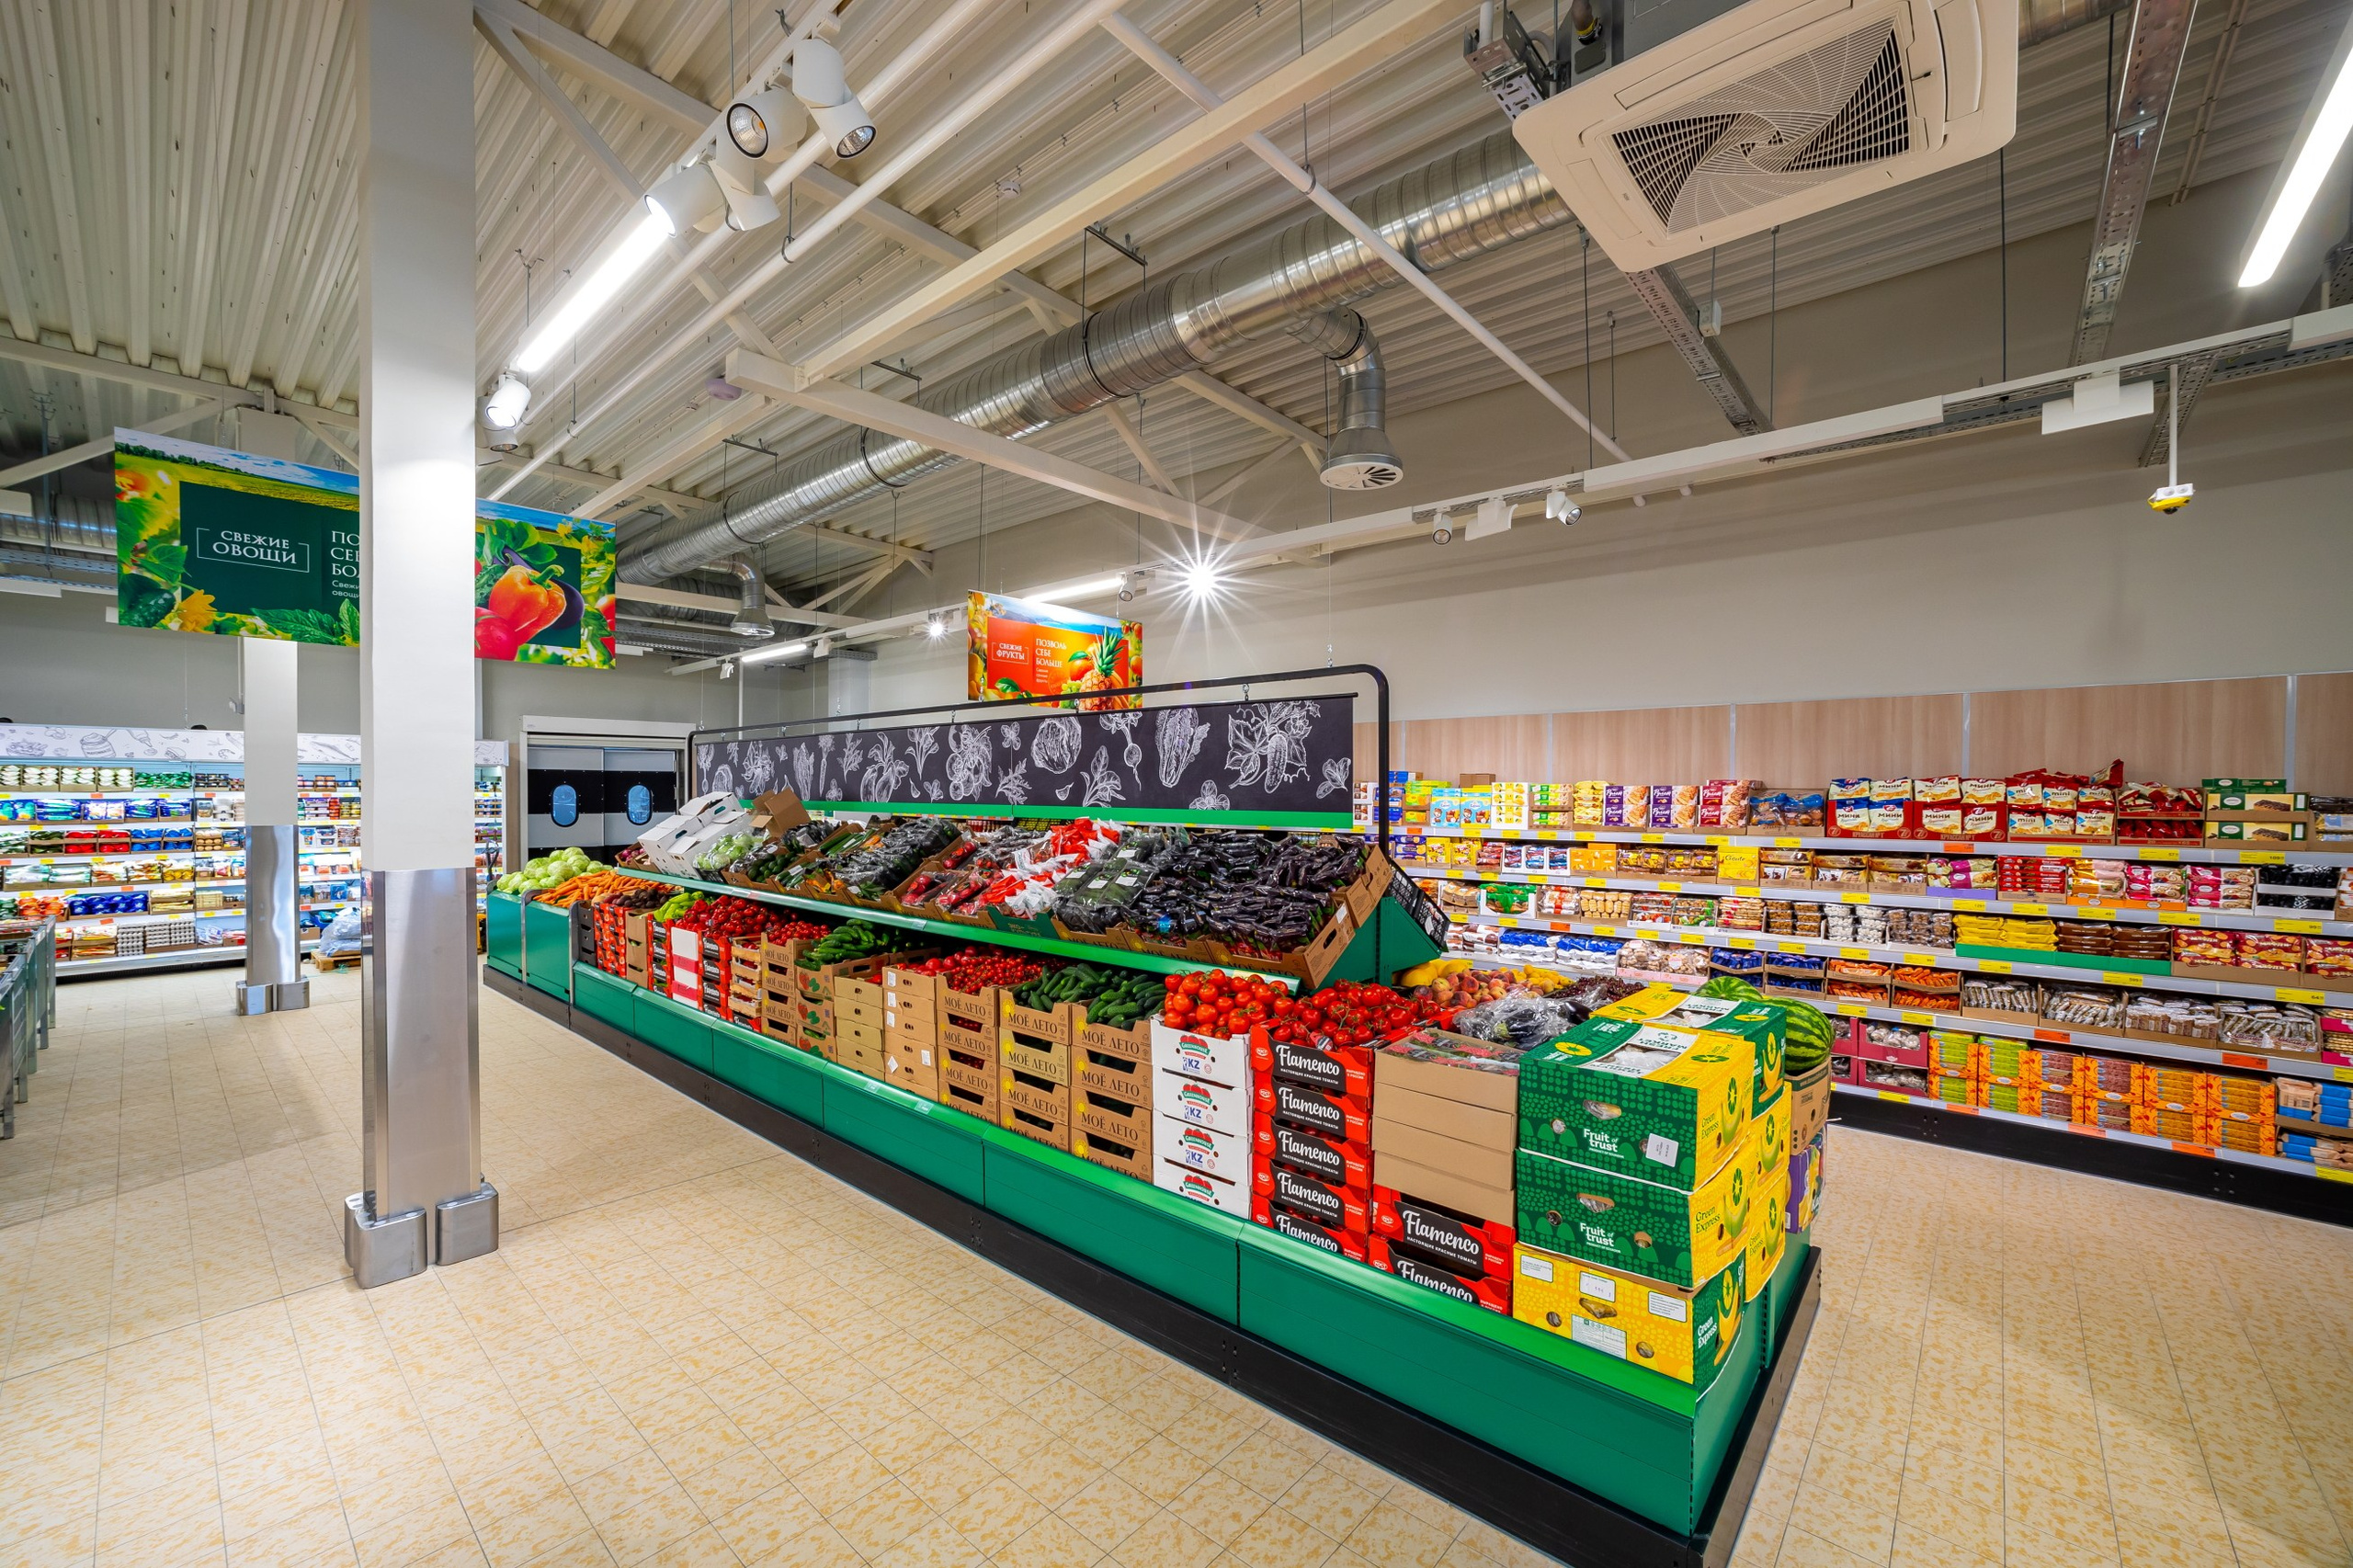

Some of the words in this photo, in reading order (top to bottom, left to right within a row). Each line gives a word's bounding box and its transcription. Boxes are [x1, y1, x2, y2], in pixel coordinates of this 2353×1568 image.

[221, 530, 290, 550] СВЕЖИЕ
[212, 541, 297, 564] ОВОЩИ
[332, 580, 360, 589] Свежи
[996, 650, 1025, 660] ФРУКТЫ
[999, 643, 1022, 652] СВЕЖИЕ
[1035, 648, 1051, 657] СЕБЕ
[1036, 639, 1067, 650] ПОЗВОЛЬ
[1036, 657, 1063, 667] БОЛЬШЕ
[944, 996, 961, 1009] МОЁ
[964, 1004, 986, 1017] ЛЕТО
[1008, 1013, 1029, 1027] МОЁ
[1032, 1019, 1058, 1034] ЛЕТО
[944, 1030, 961, 1044] МОЁ
[964, 1038, 986, 1052] ЛЕТО
[1082, 1029, 1106, 1046] МОЁ
[1109, 1037, 1140, 1054] ЛЕТО
[1008, 1051, 1029, 1066] МОЁ
[1032, 1059, 1057, 1074] ЛЕТО
[1276, 1044, 1340, 1075] Flamenco
[946, 1067, 963, 1081] МОЁ
[966, 1074, 988, 1090] ЛЕТО
[1082, 1070, 1106, 1087] МОЁ
[1109, 1078, 1140, 1096] ЛЕТО
[1008, 1089, 1029, 1103] МОЁ
[1032, 1096, 1058, 1116] ЛЕТО
[1279, 1087, 1340, 1120] Flamenco
[1081, 1111, 1106, 1129] МОЁ
[1108, 1122, 1138, 1142] ЛЕТО
[1701, 1112, 1716, 1128] Green
[1701, 1121, 1721, 1140] Express
[1584, 1128, 1609, 1143] Fruit
[1589, 1137, 1618, 1153] trust
[1279, 1131, 1340, 1165] Flamenco
[1277, 1172, 1339, 1209] Flamenco
[1695, 1205, 1716, 1222] Green
[1696, 1214, 1722, 1233] Express
[1276, 1214, 1338, 1252] Flamenco
[1402, 1210, 1479, 1256] Flamenco
[1580, 1222, 1606, 1237] Fruit
[1586, 1231, 1614, 1246] trust
[1397, 1260, 1472, 1302] Flamenco
[1698, 1315, 1714, 1336] Green
[1698, 1324, 1718, 1348] Express
